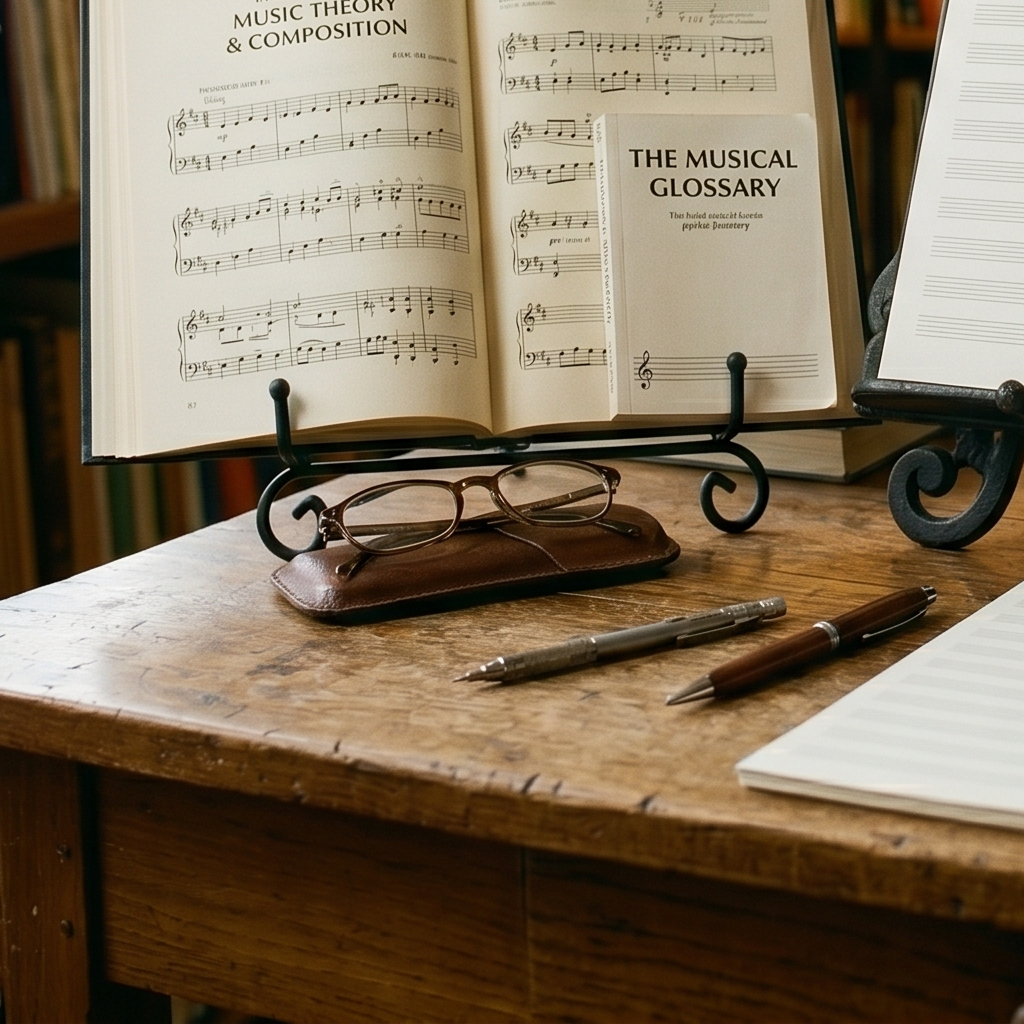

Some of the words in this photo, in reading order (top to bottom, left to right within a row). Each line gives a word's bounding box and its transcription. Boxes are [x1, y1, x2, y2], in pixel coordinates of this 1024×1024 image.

[233, 4, 304, 29] MUSIC
[226, 37, 242, 54] &
[248, 19, 408, 50] COMPOSITION
[628, 148, 678, 169] THE
[685, 149, 798, 169] MUSICAL
[649, 177, 781, 198] GLOSSARY
